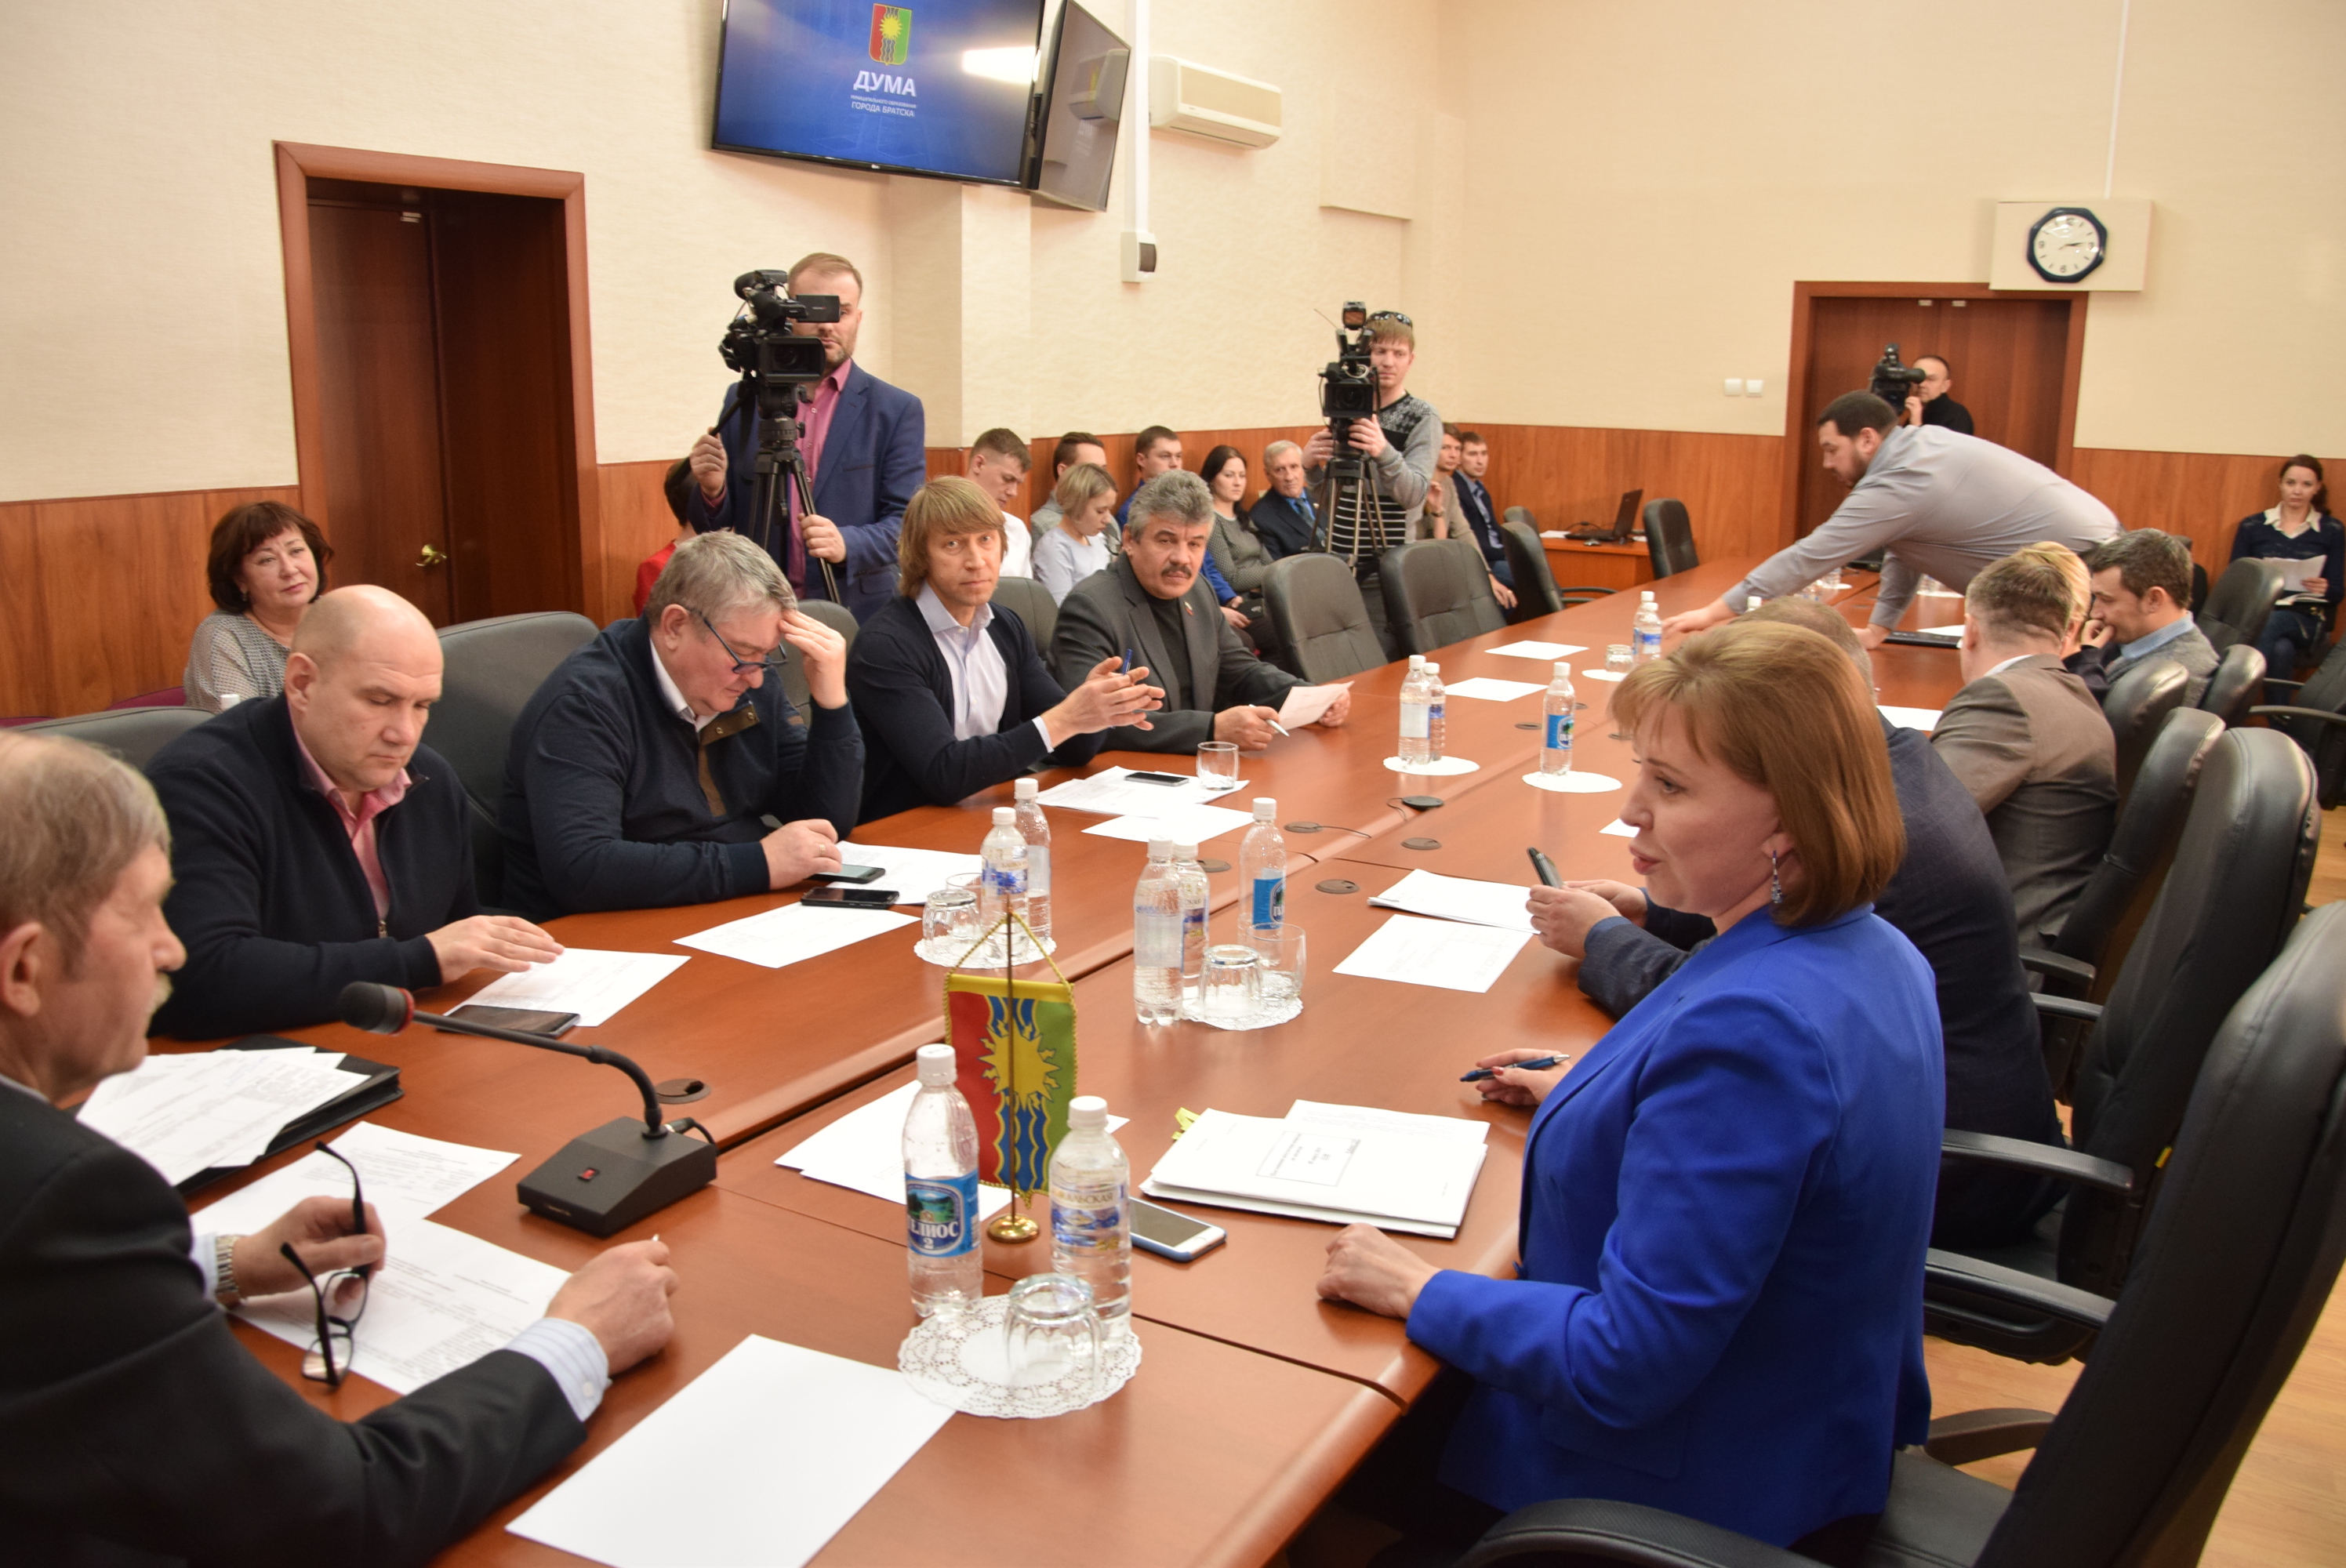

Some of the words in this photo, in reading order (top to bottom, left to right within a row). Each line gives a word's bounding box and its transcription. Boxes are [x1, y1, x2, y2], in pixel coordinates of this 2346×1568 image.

[853, 71, 916, 97] ДУМА
[852, 101, 880, 112] ГОРОДА
[882, 106, 914, 117] БРАТСКА
[924, 1238, 934, 1249] 2
